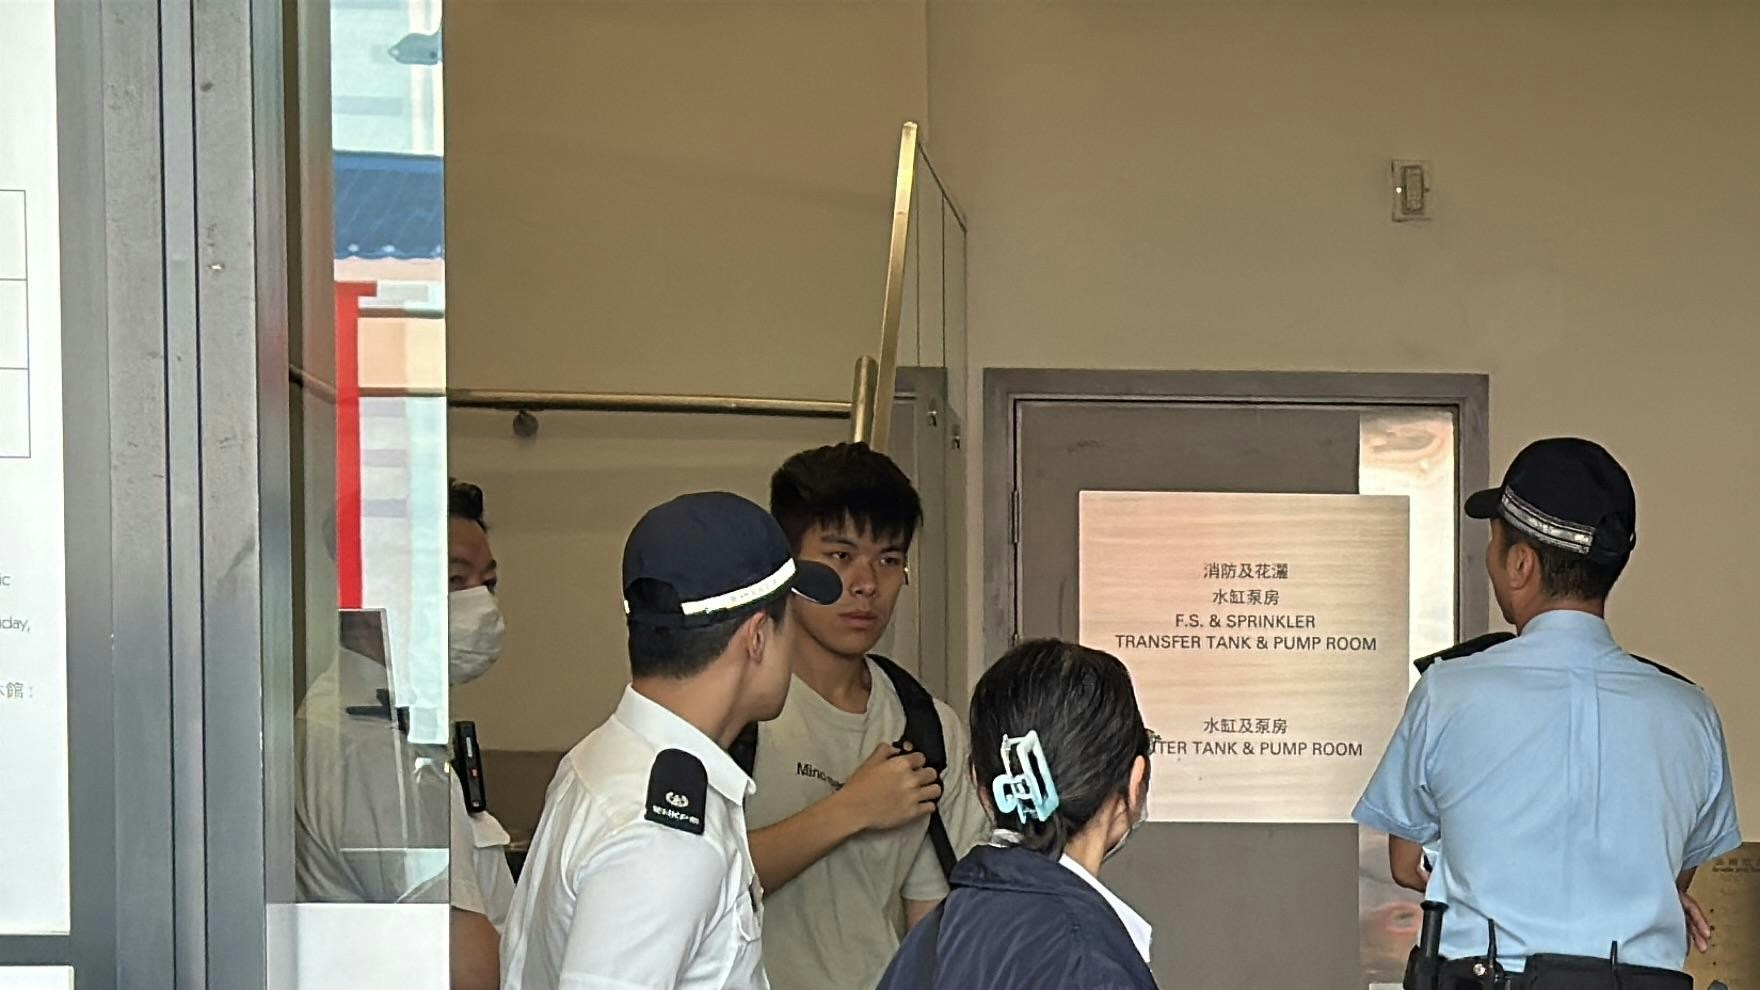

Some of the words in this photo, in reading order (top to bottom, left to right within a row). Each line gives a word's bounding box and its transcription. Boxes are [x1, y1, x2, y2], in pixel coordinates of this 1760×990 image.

[1203, 561, 1289, 579] 消防及花灑
[1212, 588, 1280, 606] 水缸泵房
[1175, 613, 1204, 629] F.S.
[1209, 613, 1221, 629] &
[1226, 614, 1316, 629] SPRINKLER
[1116, 634, 1201, 650] TRANSFER
[1206, 635, 1251, 650] TANK
[1256, 635, 1270, 651] &
[1273, 636, 1322, 651] PUMP
[1326, 636, 1377, 651] ROOM
[1203, 717, 1289, 734] 水缸及泵房
[1155, 740, 1187, 755] TER
[1192, 741, 1238, 755] TANK
[1242, 741, 1255, 755] &
[1260, 741, 1309, 756] PUMP
[1312, 741, 1363, 757] ROOM
